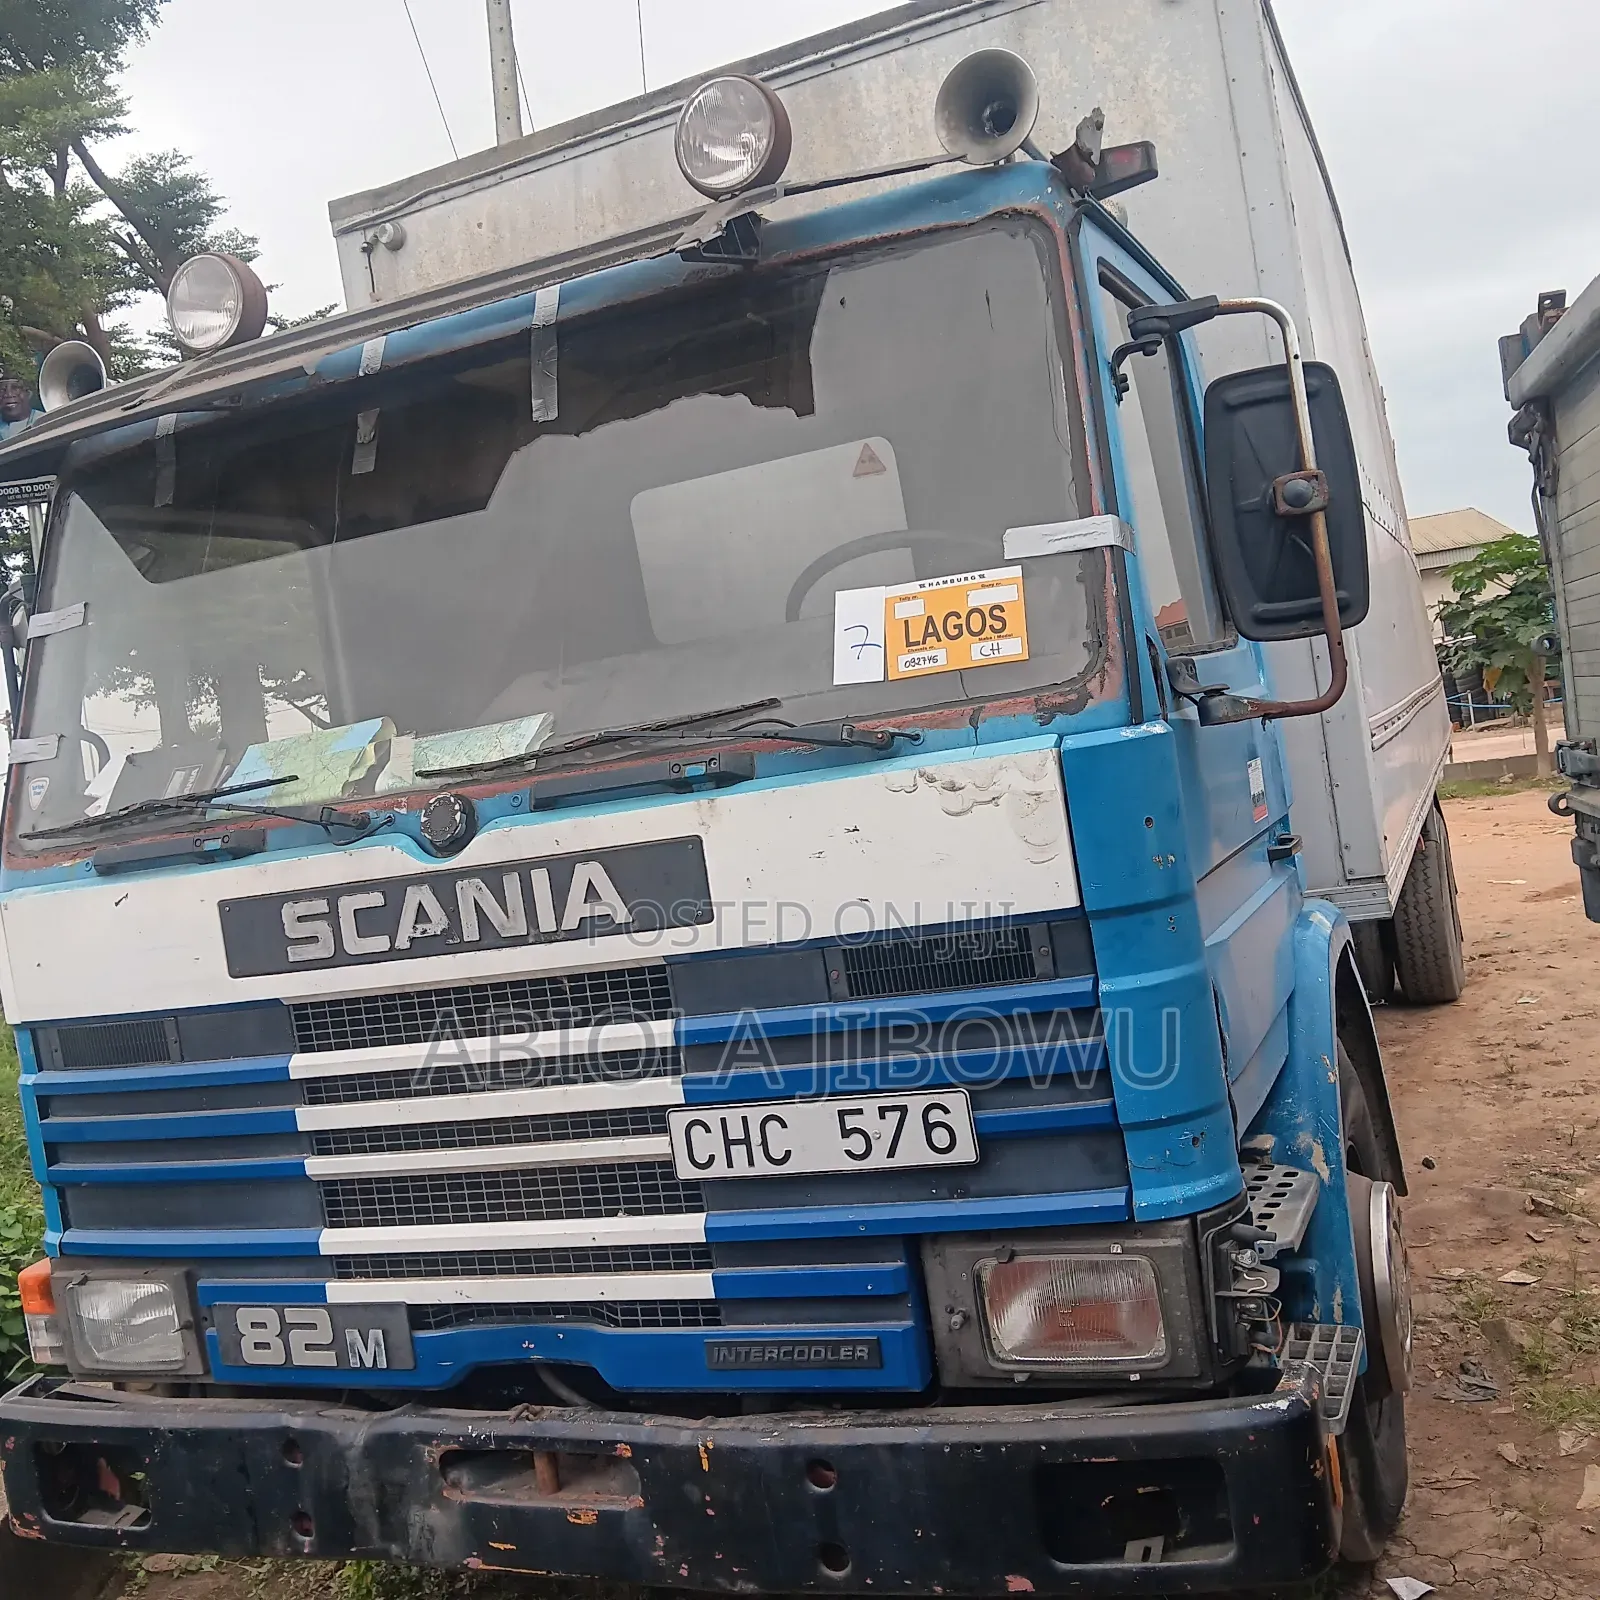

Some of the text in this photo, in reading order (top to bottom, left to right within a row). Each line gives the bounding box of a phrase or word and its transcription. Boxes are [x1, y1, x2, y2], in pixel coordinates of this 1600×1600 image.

[21, 485, 32, 493] TO
[928, 575, 976, 588] HAMBURG
[844, 625, 882, 660] 7
[904, 604, 1007, 648] LAGOS
[980, 642, 1002, 657] CH
[281, 860, 635, 963] SCANIA
[684, 1101, 958, 1171] CHC 576
[236, 1307, 388, 1369] 82 M
[712, 1344, 870, 1364] INTERCOOLER
